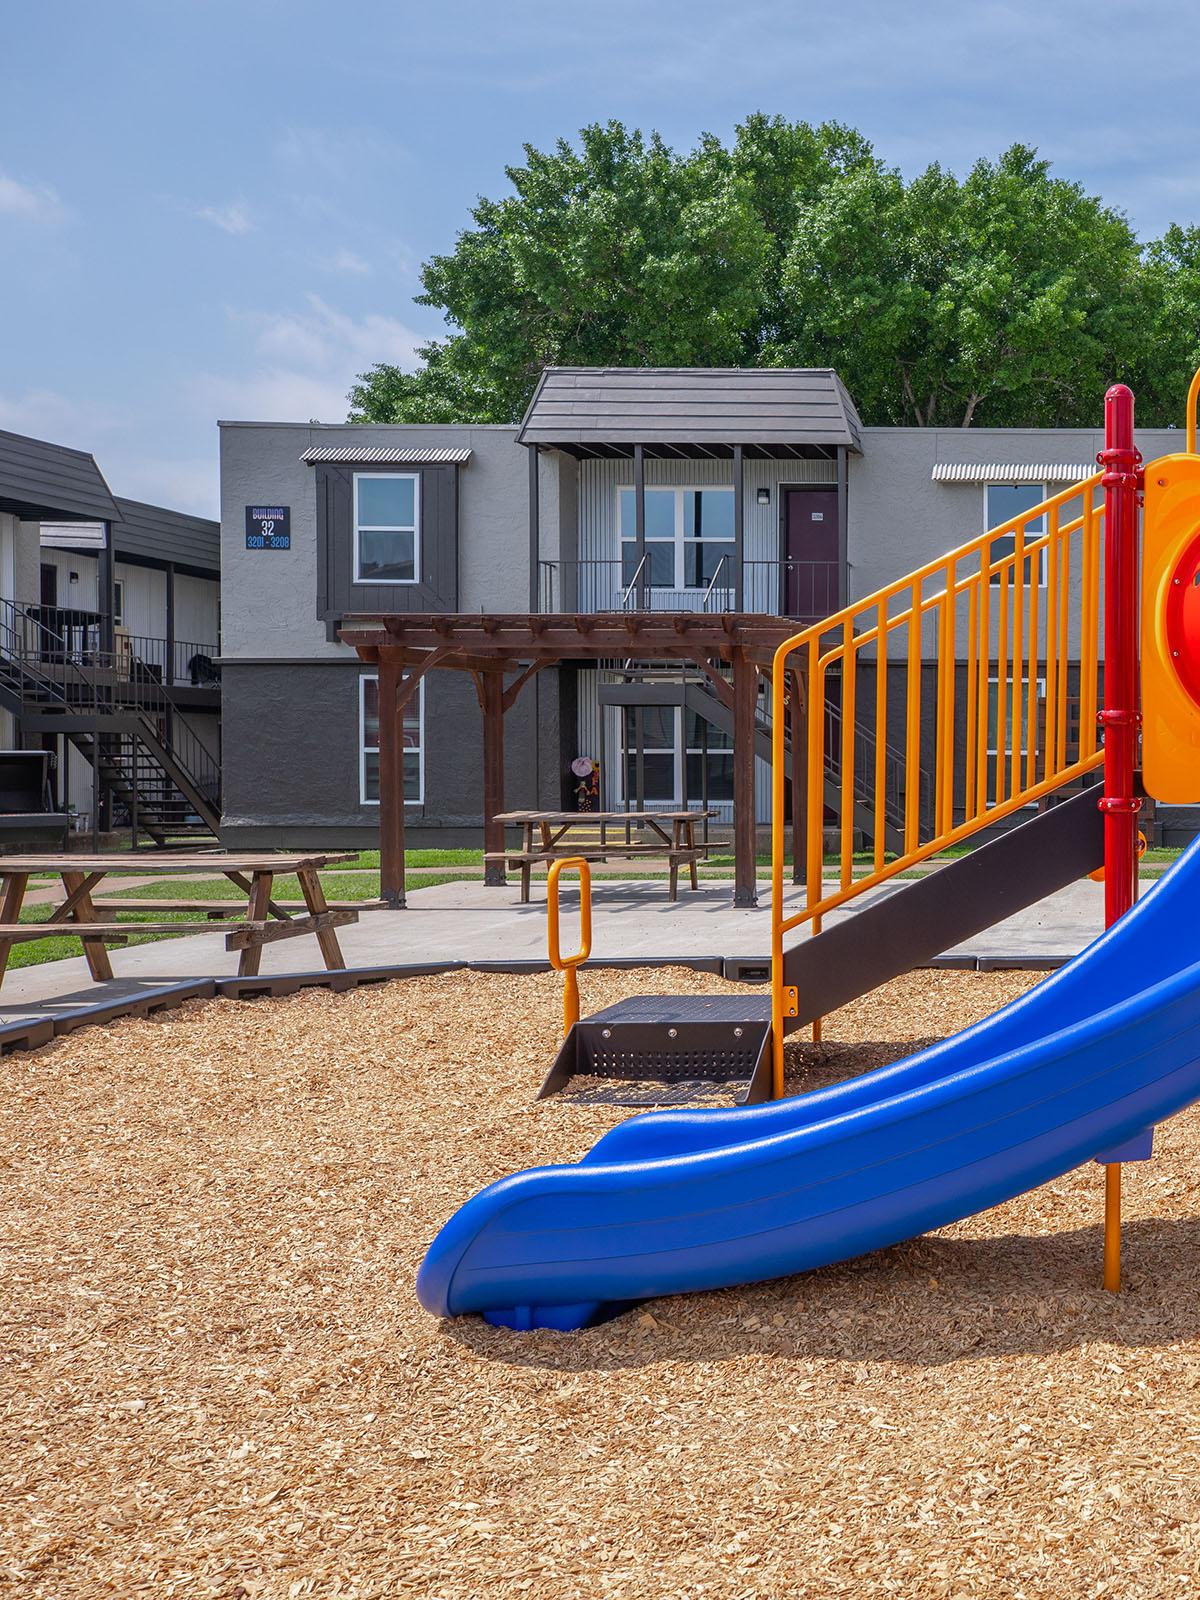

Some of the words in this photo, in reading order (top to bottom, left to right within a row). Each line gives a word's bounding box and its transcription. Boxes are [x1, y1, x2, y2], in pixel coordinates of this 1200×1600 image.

[252, 508, 284, 520] BUILDING
[261, 520, 275, 536] 32
[247, 536, 264, 548] 3201
[270, 536, 289, 548] 3208
